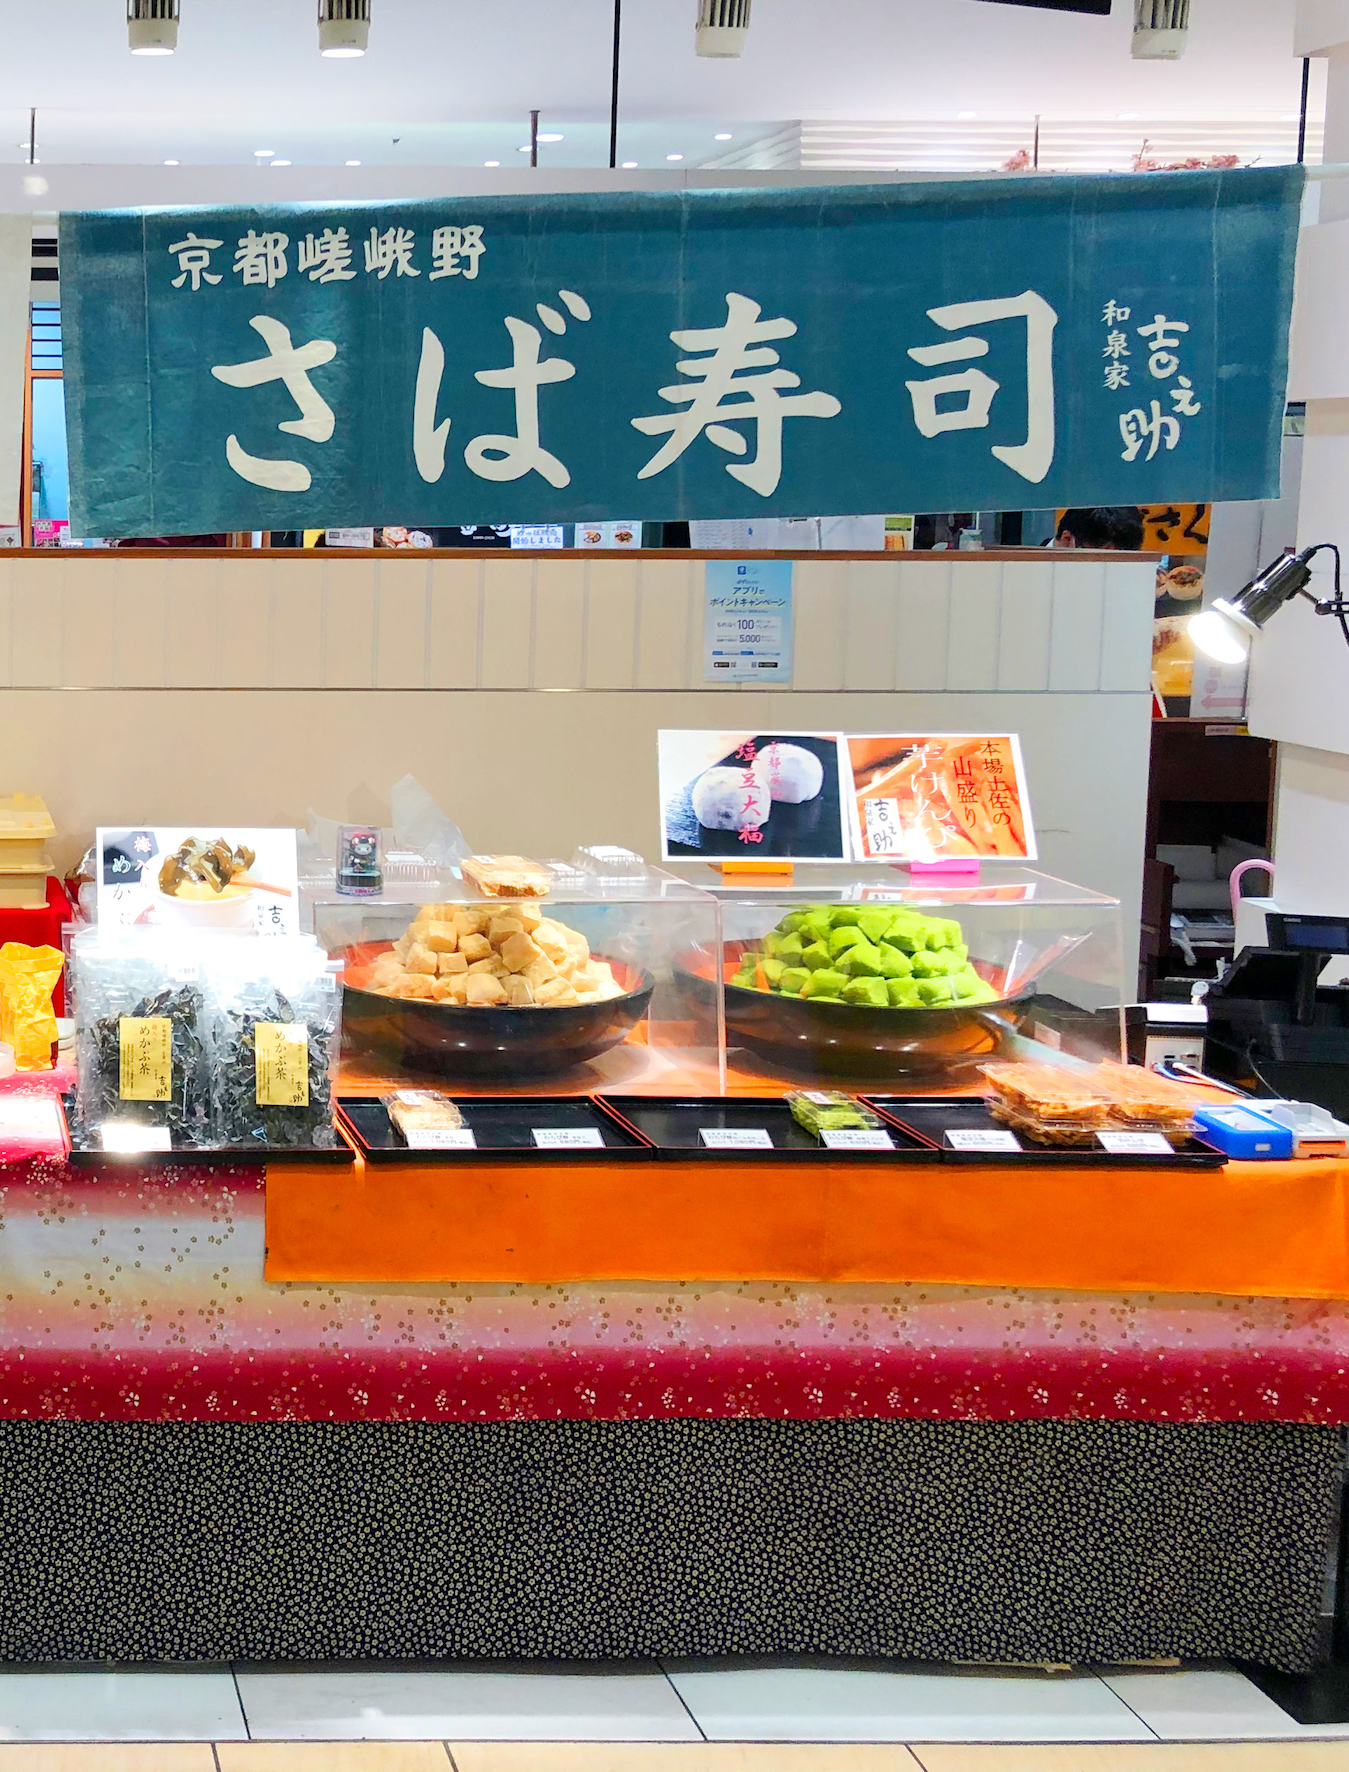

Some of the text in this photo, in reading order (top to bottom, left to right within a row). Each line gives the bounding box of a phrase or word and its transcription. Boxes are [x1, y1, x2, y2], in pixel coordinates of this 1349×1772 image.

[168, 224, 487, 291] 京都嵯峨野
[1101, 299, 1132, 390] 和泉家
[211, 289, 1058, 498] さば寿司
[1119, 314, 1202, 463] 吉之助
[737, 619, 754, 630] 100
[735, 740, 764, 844] 塩豆大福
[901, 743, 958, 848] 芋けんぴ
[953, 756, 978, 828] 山盛り
[980, 740, 1011, 826] 本場土佐の
[139, 1025, 151, 1075] めかぶ茶
[275, 1031, 286, 1080] めかぶ茶
